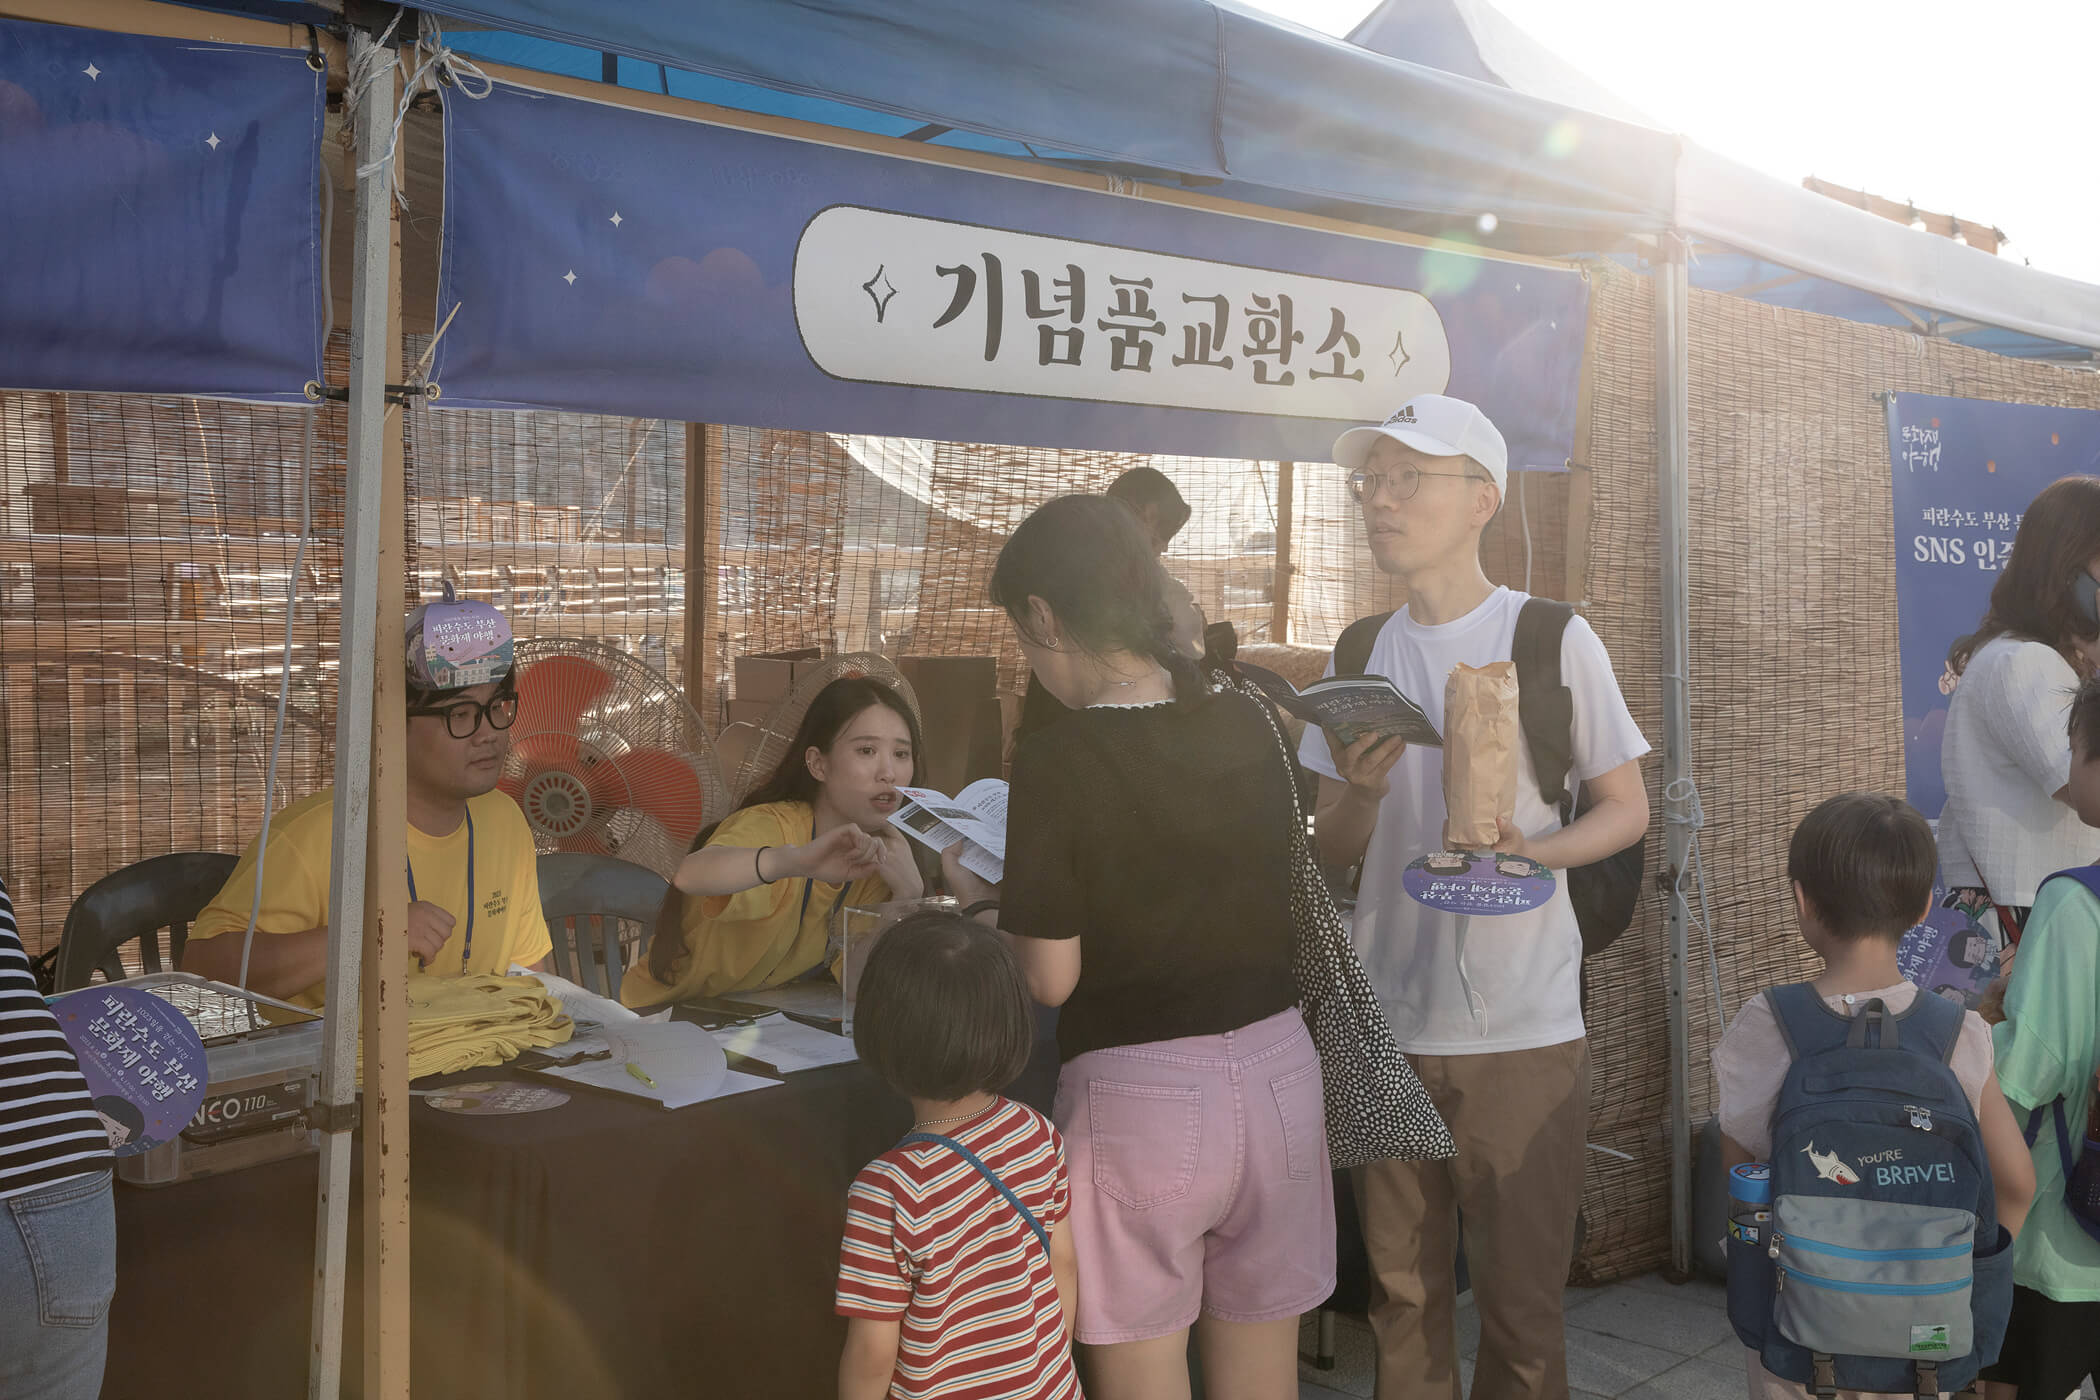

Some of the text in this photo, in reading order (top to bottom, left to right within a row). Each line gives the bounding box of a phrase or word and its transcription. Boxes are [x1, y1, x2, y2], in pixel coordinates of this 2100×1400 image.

[932, 251, 1367, 387] 기념품교환소
[1921, 507, 1979, 528] 피란수도
[1982, 511, 2011, 531] 부산
[1914, 536, 1966, 565] SNS
[1916, 925, 1939, 954] 야행
[87, 1016, 142, 1069] 문화재
[138, 1065, 175, 1102] 야행
[101, 994, 165, 1061] 피란수도
[163, 1056, 199, 1095] 부산
[244, 1095, 266, 1112] 110
[1857, 1149, 1903, 1168] YOU'RE
[1876, 1163, 1956, 1186] BRAVE!
